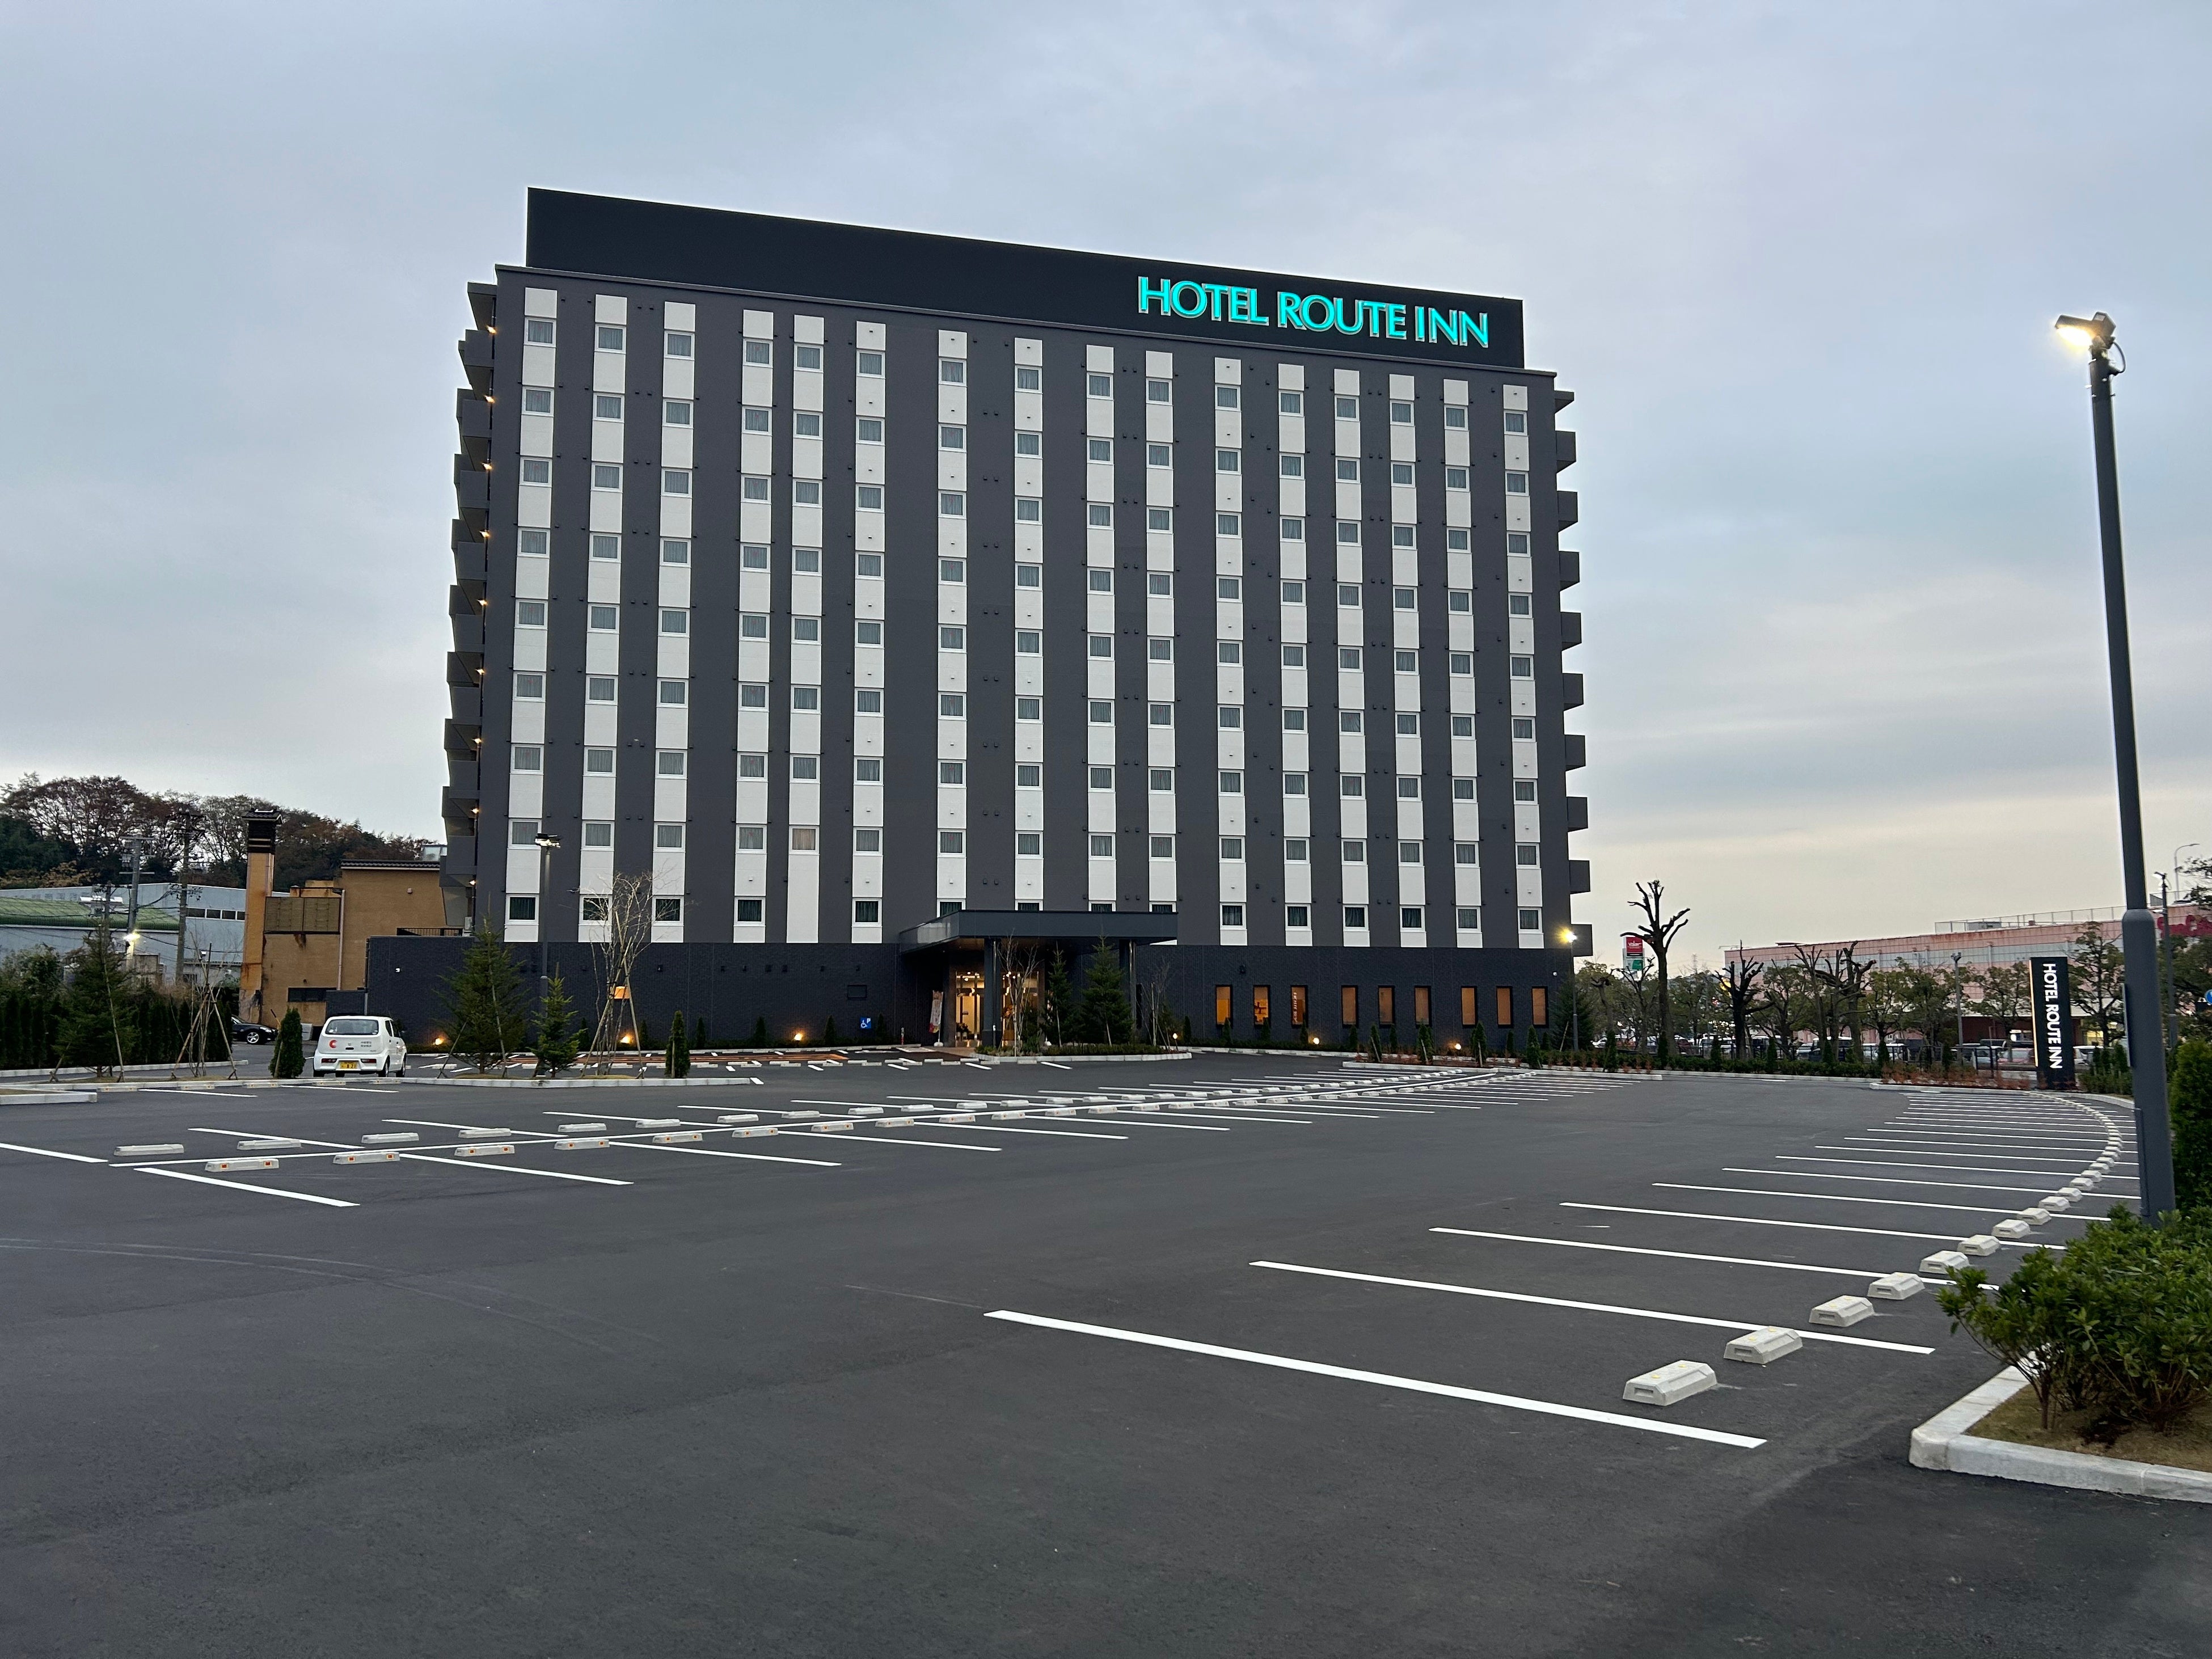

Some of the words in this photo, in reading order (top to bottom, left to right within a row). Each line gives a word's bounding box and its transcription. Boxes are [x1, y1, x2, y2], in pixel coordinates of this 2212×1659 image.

[1138, 276, 1269, 326] HOTEL
[1277, 291, 1407, 340] ROUTE
[1415, 306, 1489, 348] INN
[2043, 963, 2058, 1002] HOTEL
[2046, 1004, 2062, 1044] ROUTE
[2049, 1046, 2063, 1069] INN
